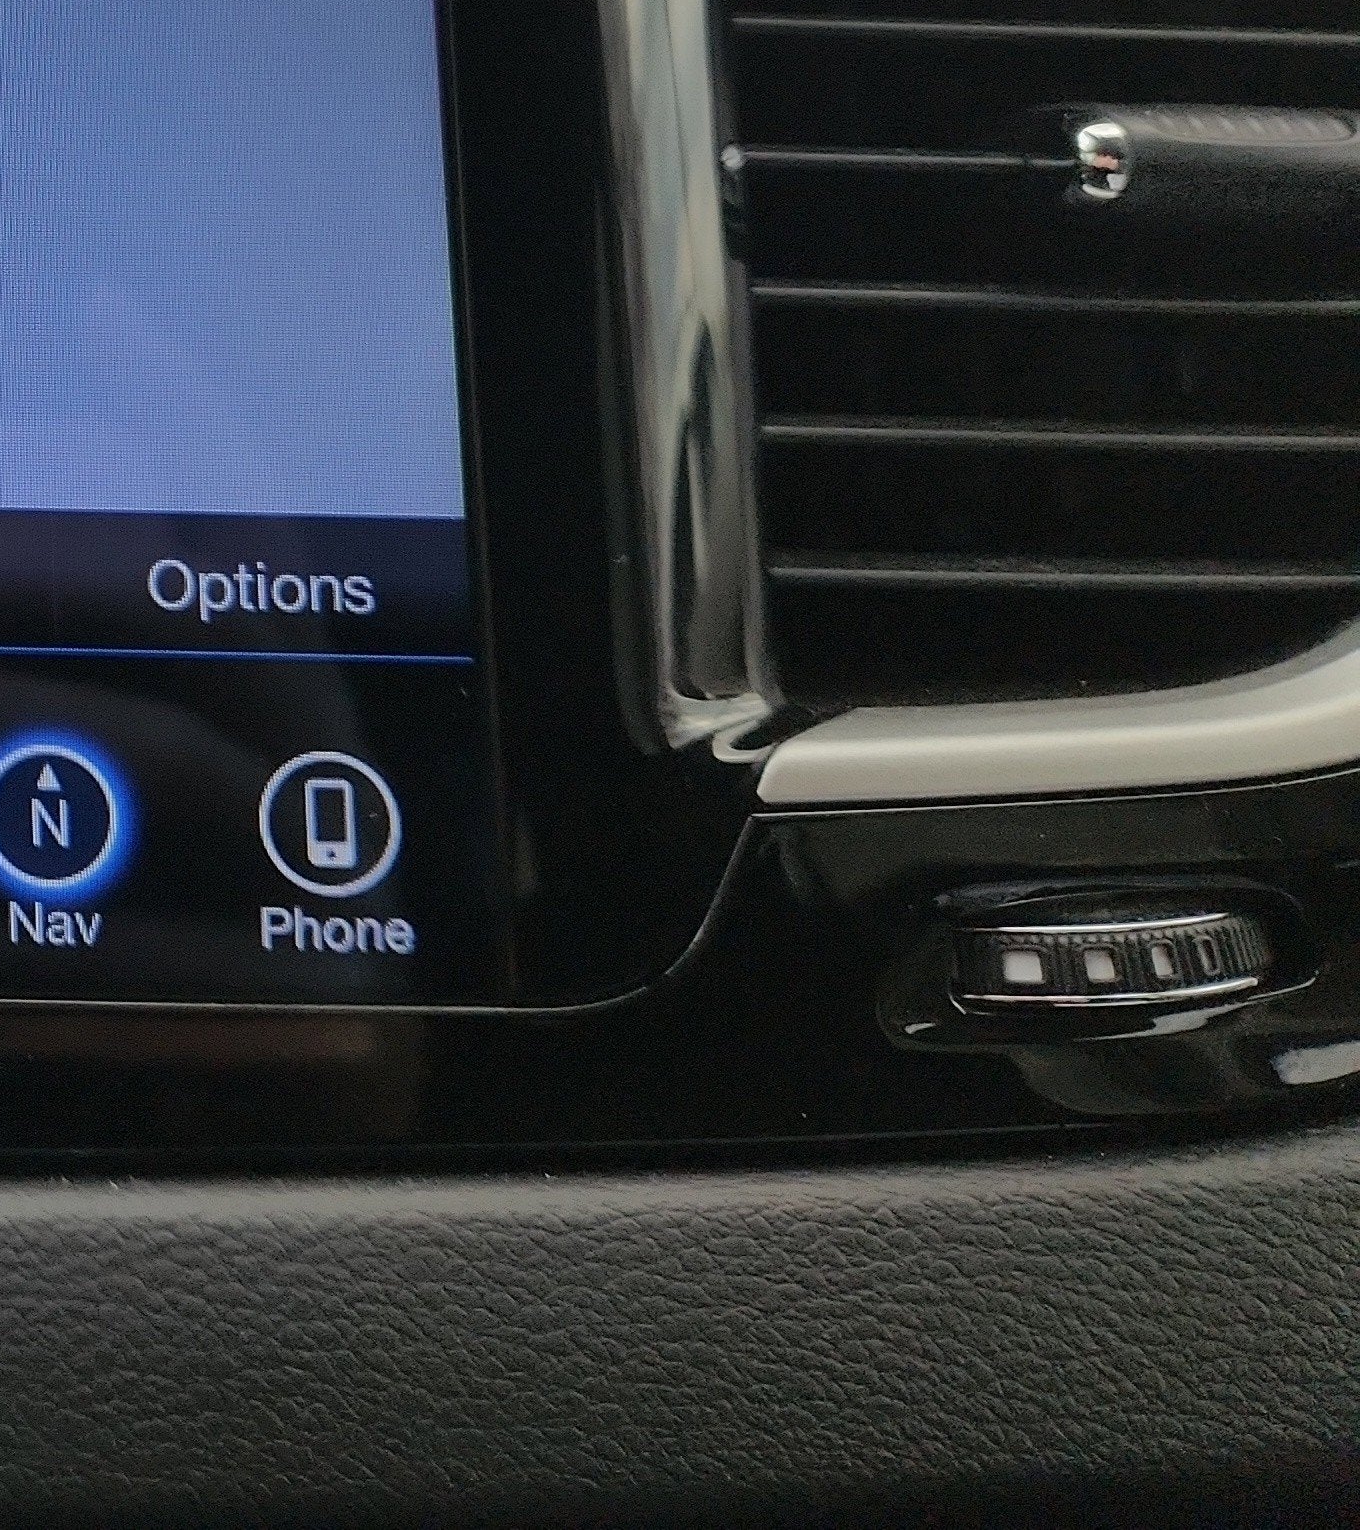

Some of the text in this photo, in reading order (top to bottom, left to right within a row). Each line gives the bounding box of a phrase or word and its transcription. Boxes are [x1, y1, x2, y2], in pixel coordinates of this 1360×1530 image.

[147, 558, 375, 622] Options
[9, 900, 101, 946] Nav
[260, 906, 415, 954] Phone
